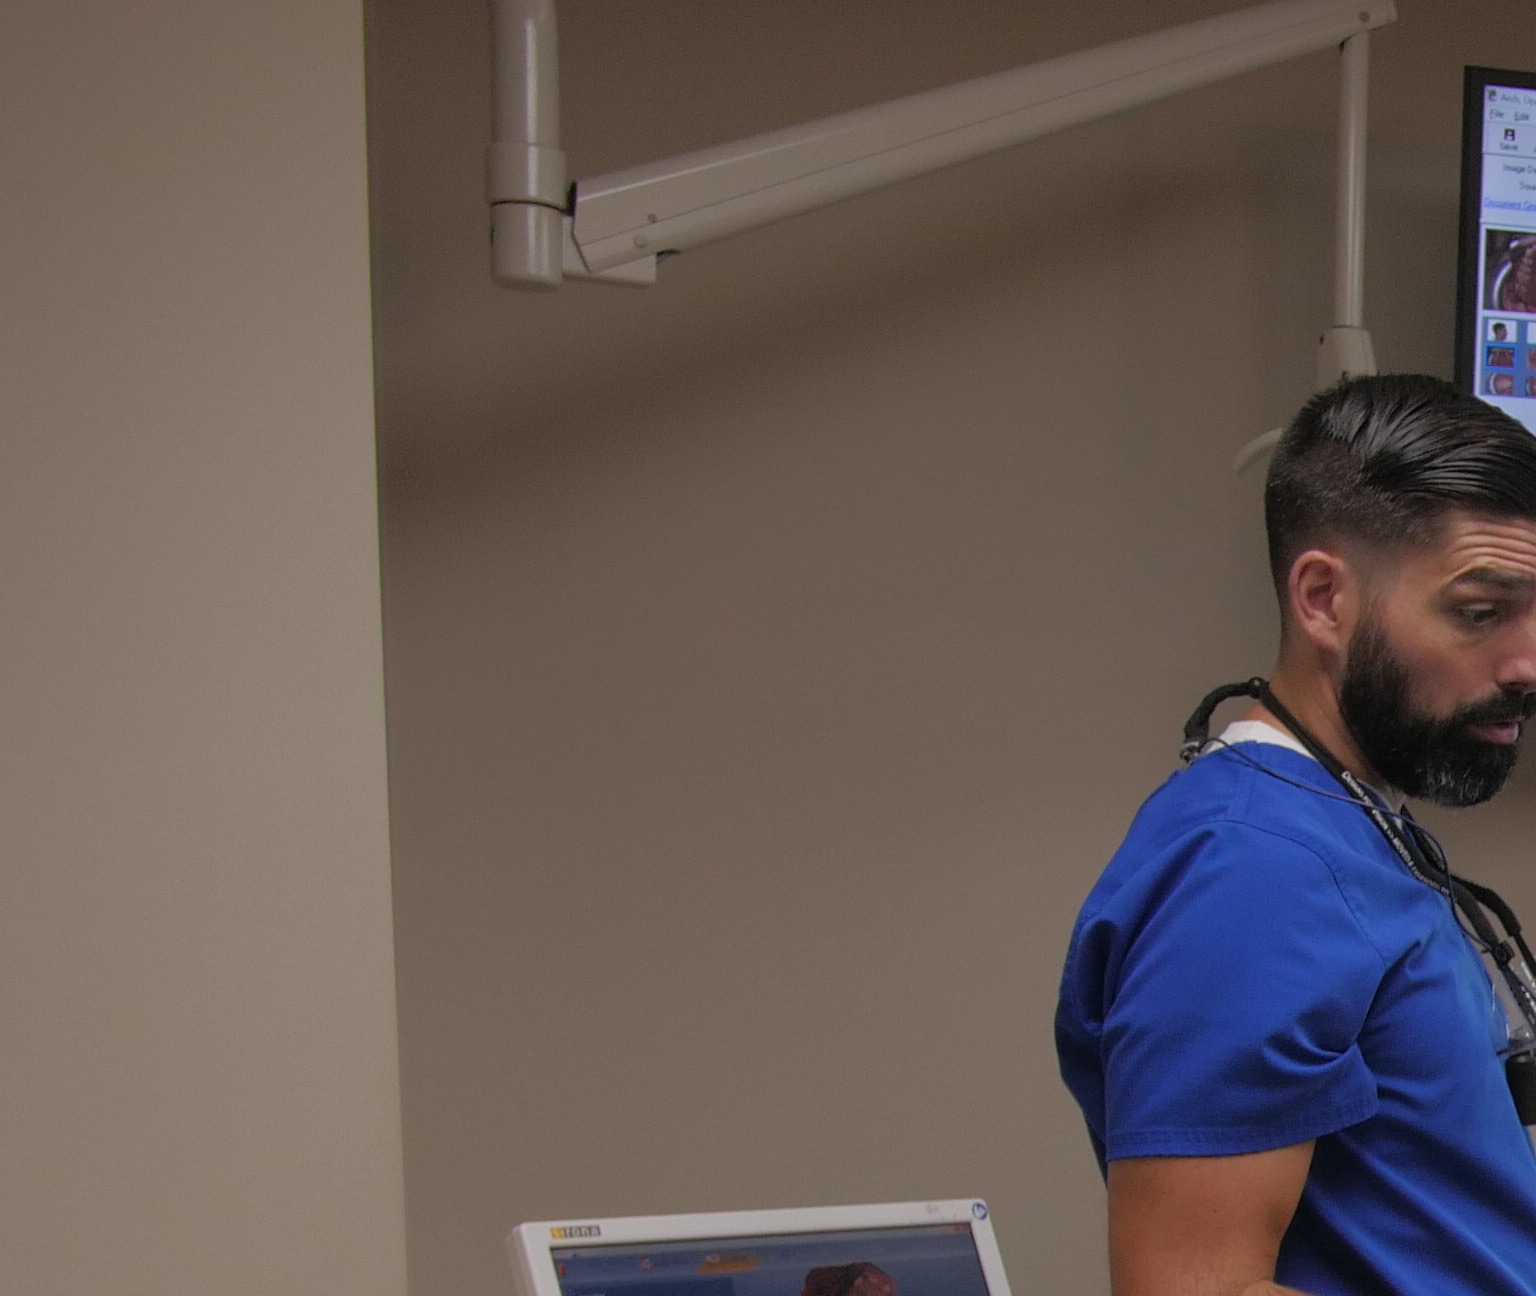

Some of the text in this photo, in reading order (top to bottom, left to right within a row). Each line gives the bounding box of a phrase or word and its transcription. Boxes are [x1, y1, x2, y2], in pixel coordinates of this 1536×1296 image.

[1489, 108, 1504, 119] File
[1514, 111, 1531, 121] Edit
[1500, 142, 1518, 152] Save
[1503, 163, 1526, 176] Image
